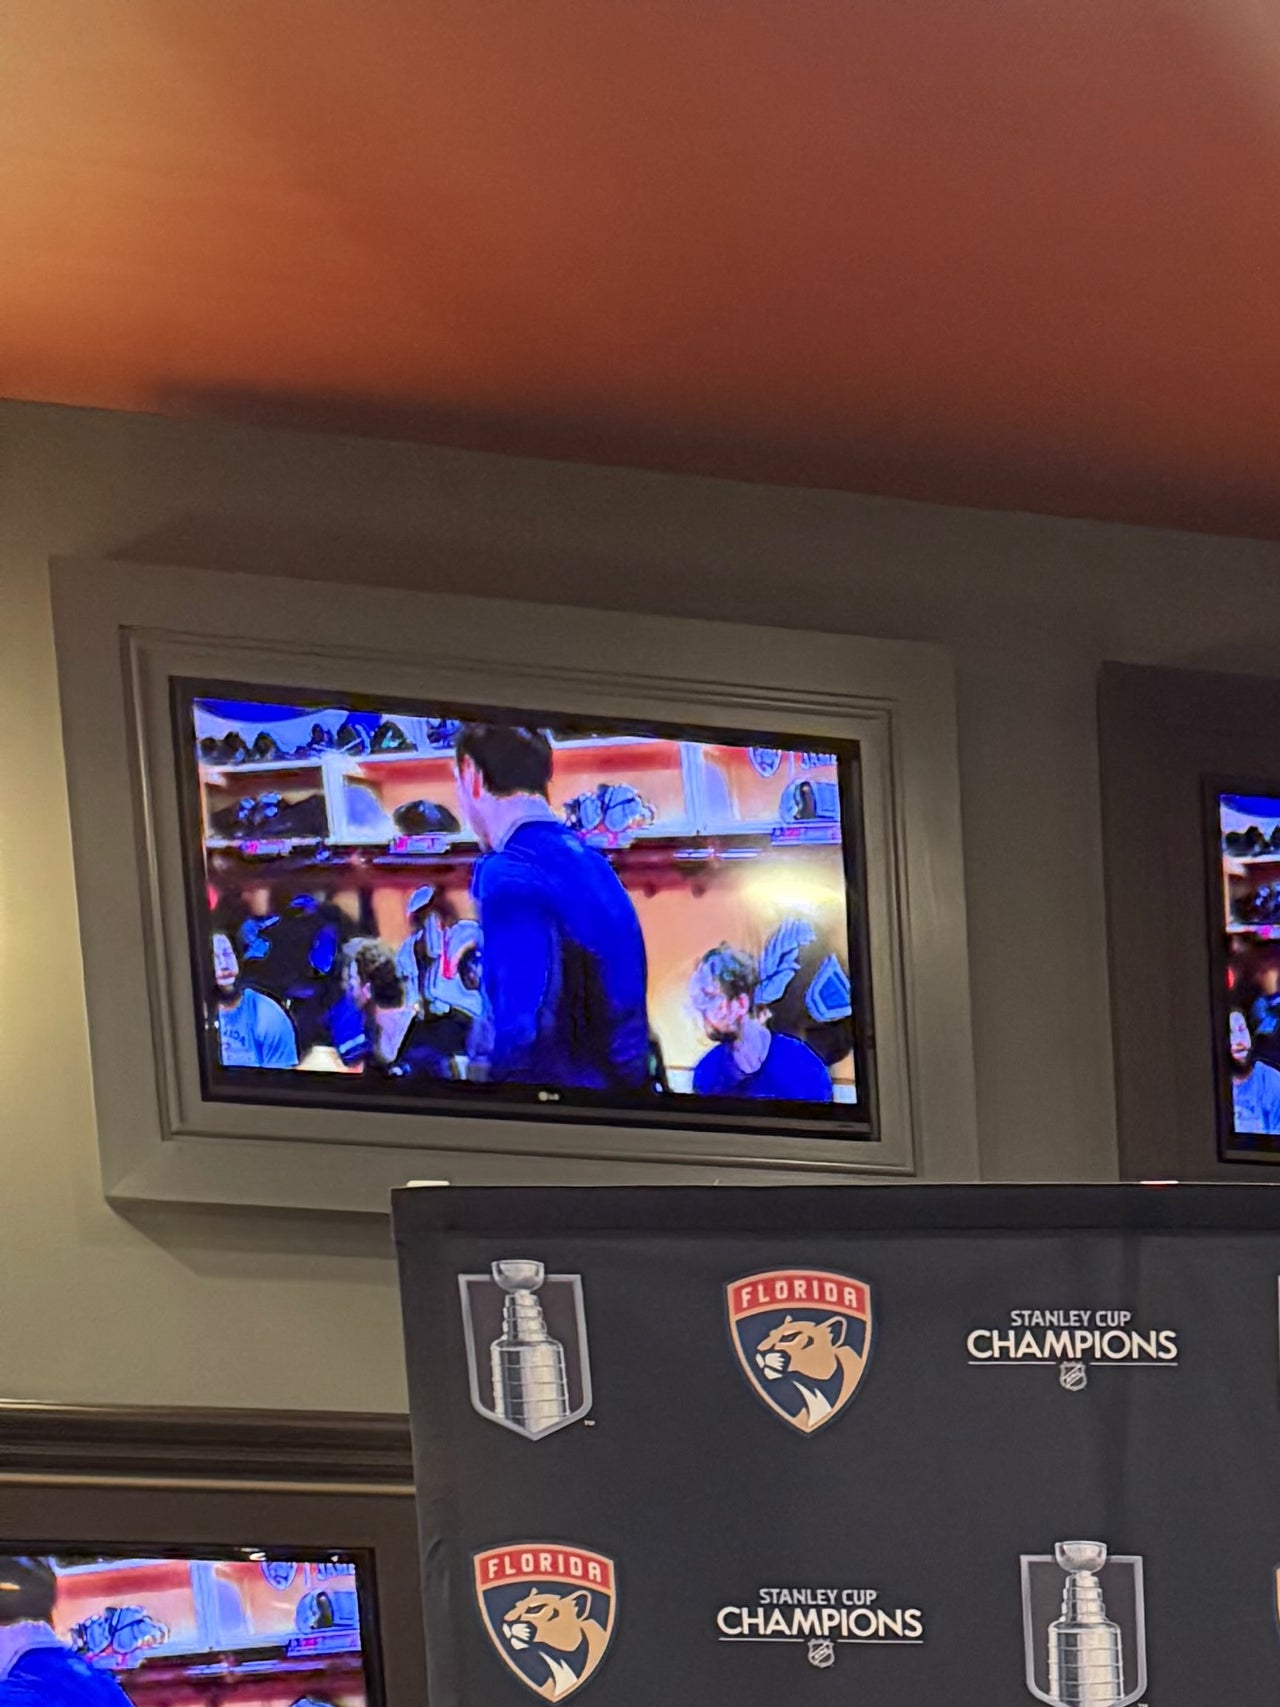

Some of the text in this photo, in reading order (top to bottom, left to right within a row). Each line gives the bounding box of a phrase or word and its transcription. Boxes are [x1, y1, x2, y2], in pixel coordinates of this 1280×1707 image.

[742, 1280, 856, 1307] FLORIDA
[1011, 1310, 1130, 1326] STANLEY CUP
[968, 1330, 1177, 1359] CHAMPIONS
[489, 1553, 600, 1582] FLORIDA
[760, 1589, 876, 1605] STANLEY CUP
[718, 1606, 922, 1637] CHAMPIONS
